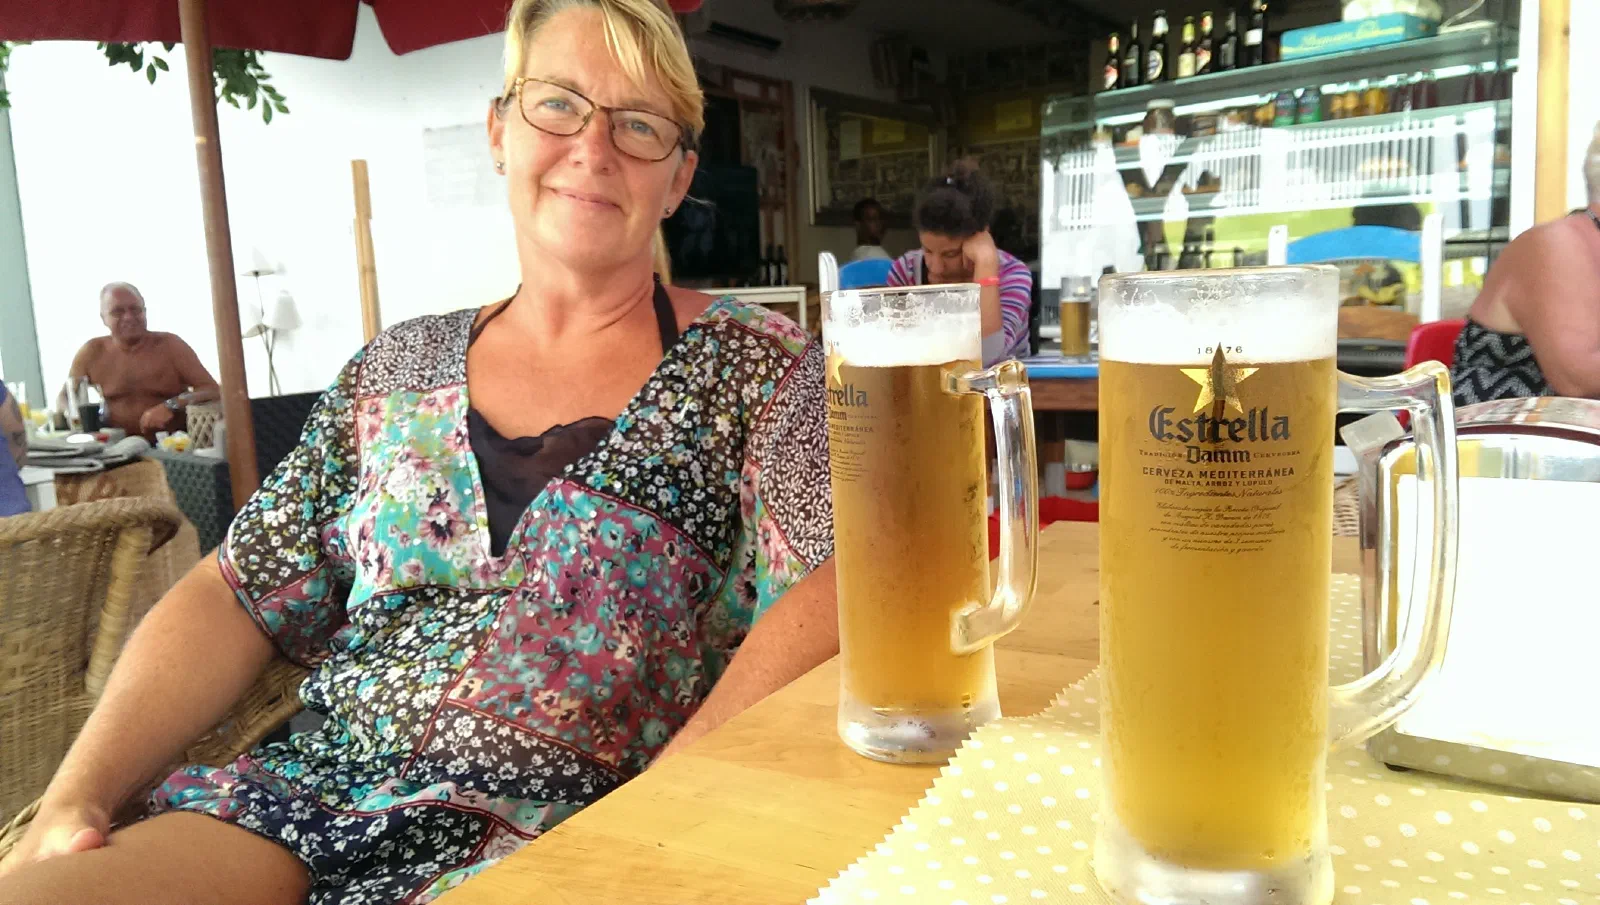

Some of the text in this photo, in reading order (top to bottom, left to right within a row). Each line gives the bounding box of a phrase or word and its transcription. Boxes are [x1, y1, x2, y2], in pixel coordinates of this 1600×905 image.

[828, 384, 868, 407] trella
[1149, 404, 1291, 443] Estrella
[1186, 445, 1251, 465] Damm
[1142, 466, 1295, 479] CERVEZA MEDITERRÁNEA
